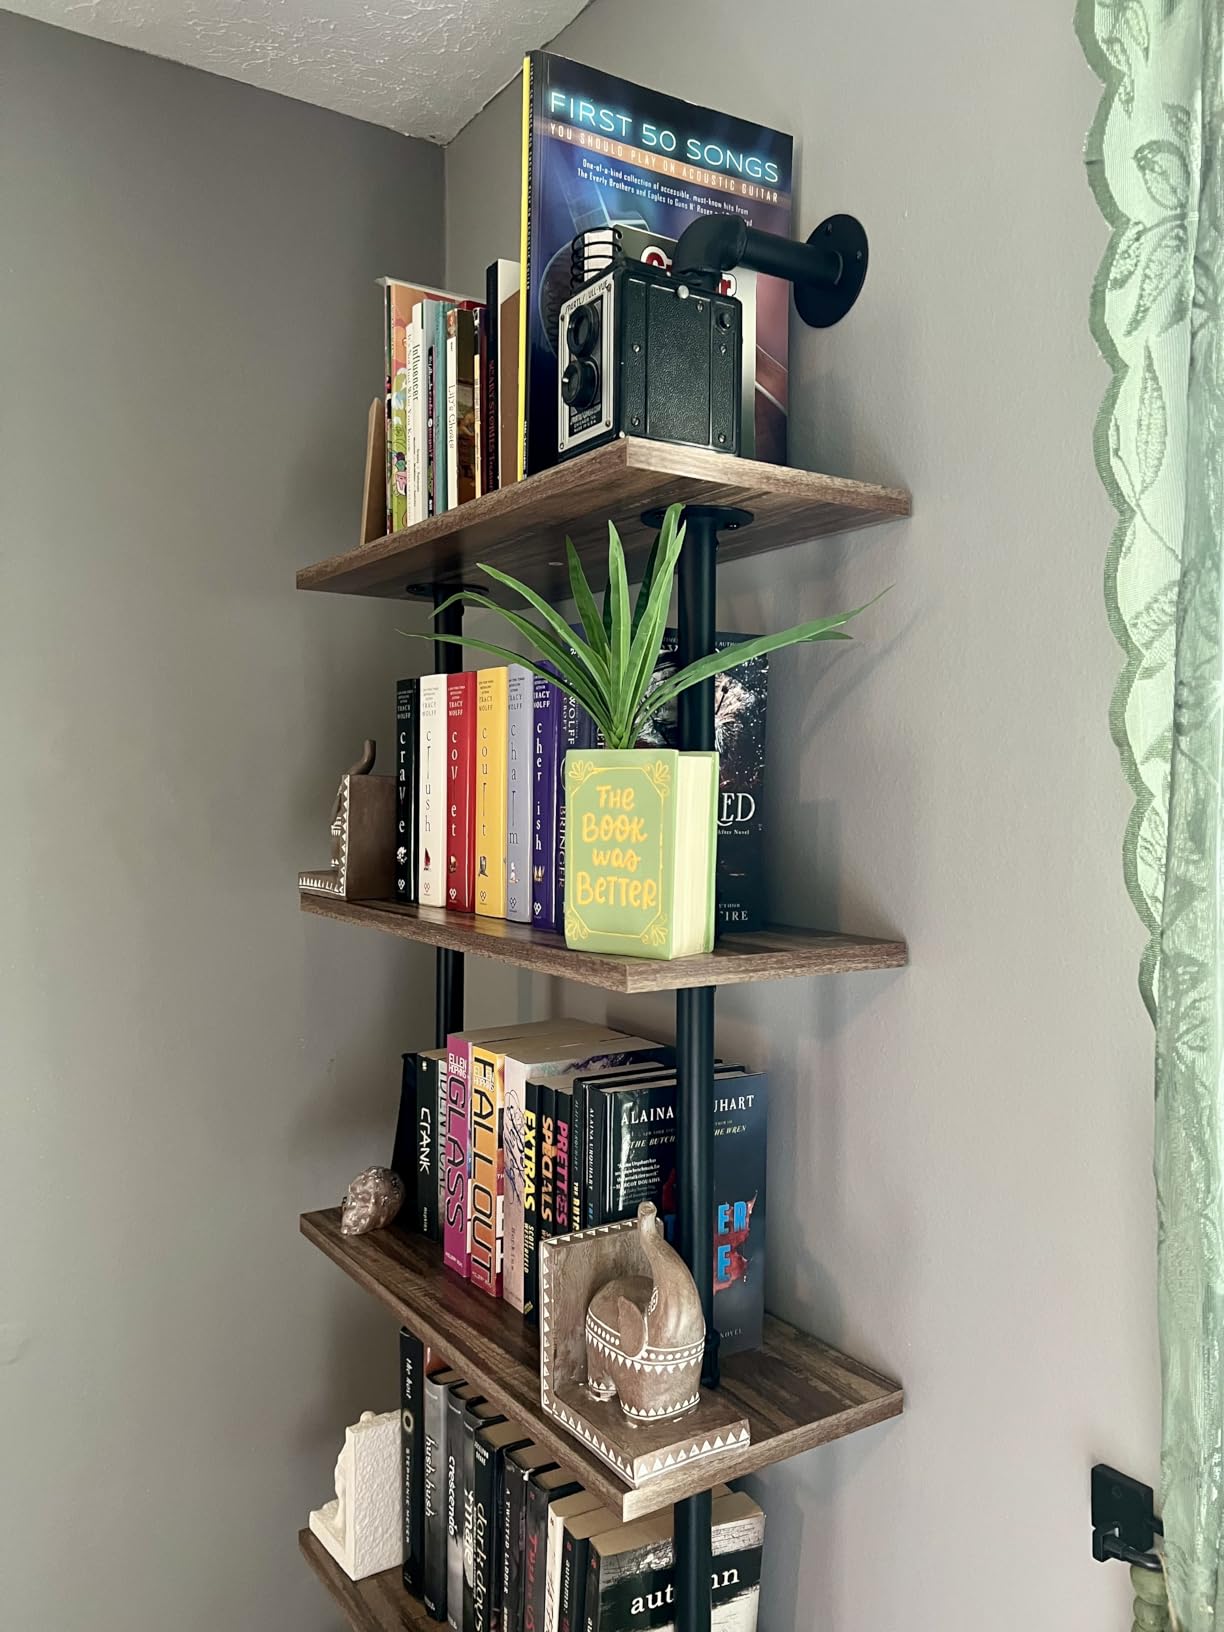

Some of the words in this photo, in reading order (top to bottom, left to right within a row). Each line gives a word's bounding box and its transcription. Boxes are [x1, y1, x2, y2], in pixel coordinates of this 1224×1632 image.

[550, 91, 632, 137] FIRST
[641, 123, 676, 151] 50
[686, 139, 779, 184] SONGS
[550, 122, 572, 140] YOU
[580, 132, 623, 157] SHOULD
[631, 146, 656, 167] PLAY
[663, 160, 676, 174] ON
[682, 167, 735, 192] ACOUSTIC
[741, 183, 779, 203] GUITAR
[577, 168, 588, 179] The
[589, 172, 608, 186] Everly
[609, 179, 634, 194] Brothers
[636, 188, 646, 197] and
[647, 191, 666, 204] Eagles
[667, 197, 673, 205] to
[674, 199, 688, 210] Guns
[582, 158, 622, 179] One-of-a-kind
[623, 173, 652, 188] collection
[653, 182, 660, 190] of
[661, 185, 691, 200] accessible,
[693, 195, 722, 208] must-know
[723, 201, 734, 212] hits
[736, 205, 749, 215] from
[568, 696, 576, 745] WOLFF
[424, 731, 432, 833] crush
[481, 727, 489, 837] court
[509, 723, 519, 845] charm
[621, 1105, 675, 1126] ALAINA
[630, 1139, 647, 1149] THE
[649, 1135, 676, 1146] BUTCH
[714, 1128, 725, 1136] HE
[446, 1075, 467, 1234] GLASS
[471, 1056, 495, 1285] FALLOUT
[524, 1108, 537, 1213] EXTRAS
[541, 1114, 554, 1222] SPECIALS
[556, 1119, 569, 1227] PRETTIES
[572, 1198, 581, 1231] BUTC
[425, 1479, 437, 1517] hush
[449, 1455, 458, 1536] crescendo
[476, 1502, 488, 1569] dark
[475, 1570, 487, 1632] days
[563, 1559, 571, 1614] autumn:
[630, 1568, 740, 1615] autn
